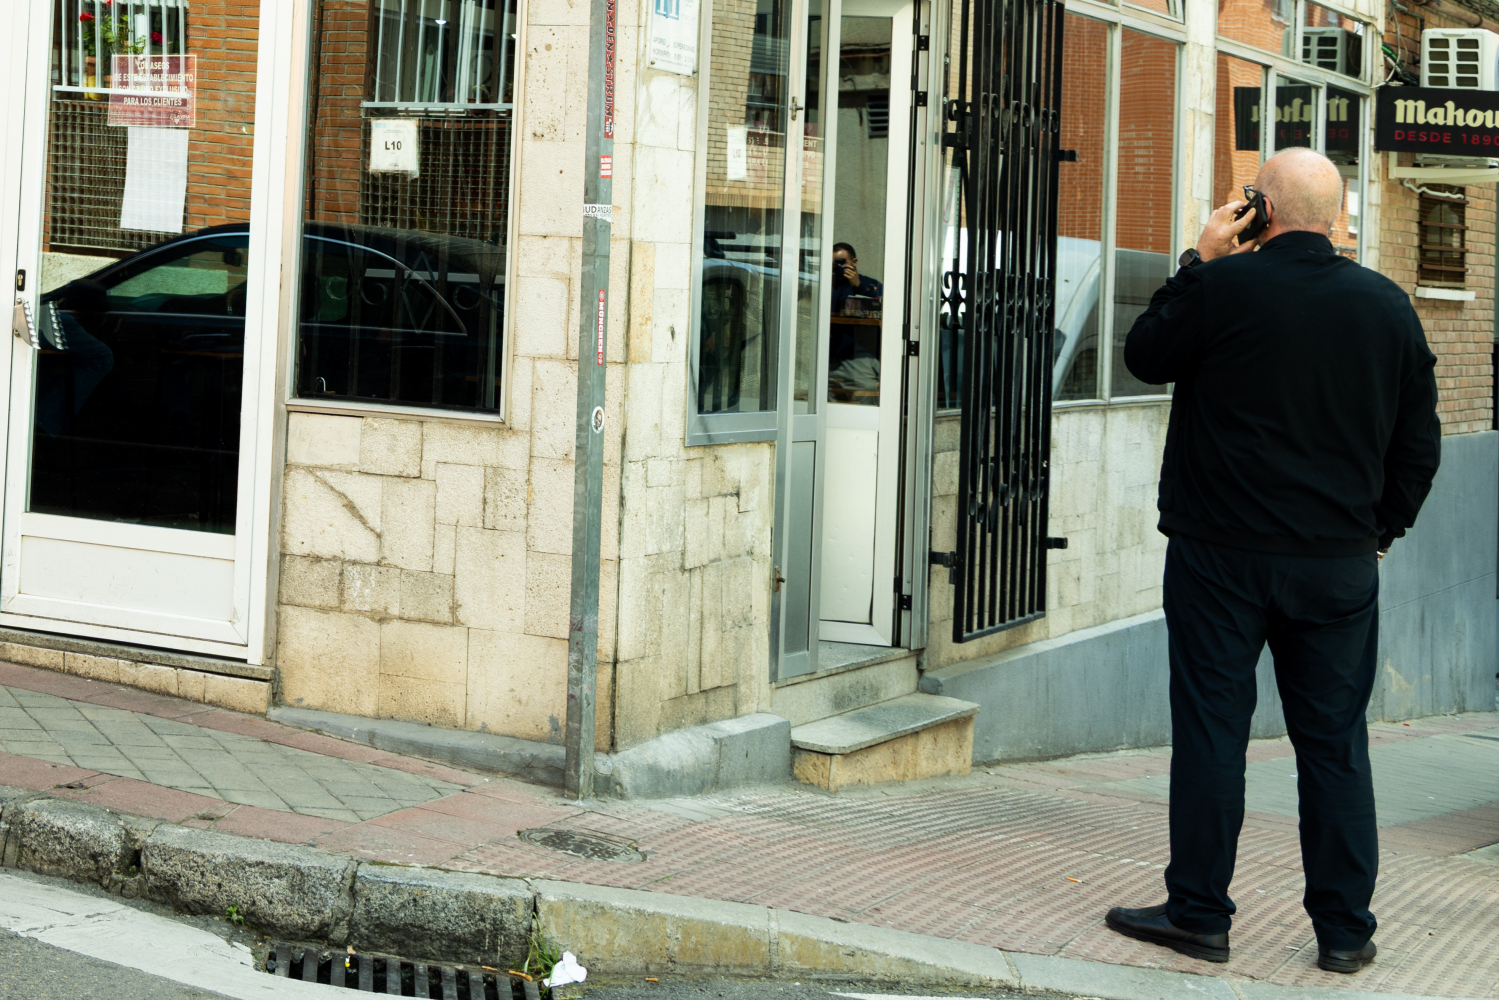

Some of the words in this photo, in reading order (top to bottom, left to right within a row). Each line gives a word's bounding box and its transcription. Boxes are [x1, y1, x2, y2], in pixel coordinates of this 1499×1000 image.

[150, 61, 170, 70] ASEOS
[123, 97, 139, 106] PARA
[141, 97, 152, 106] LOS
[153, 97, 182, 106] CLIENTES
[1393, 99, 1499, 128] Mahou
[1394, 130, 1451, 144] DESDE
[1461, 133, 1499, 146] 1890
[384, 140, 403, 151] L10
